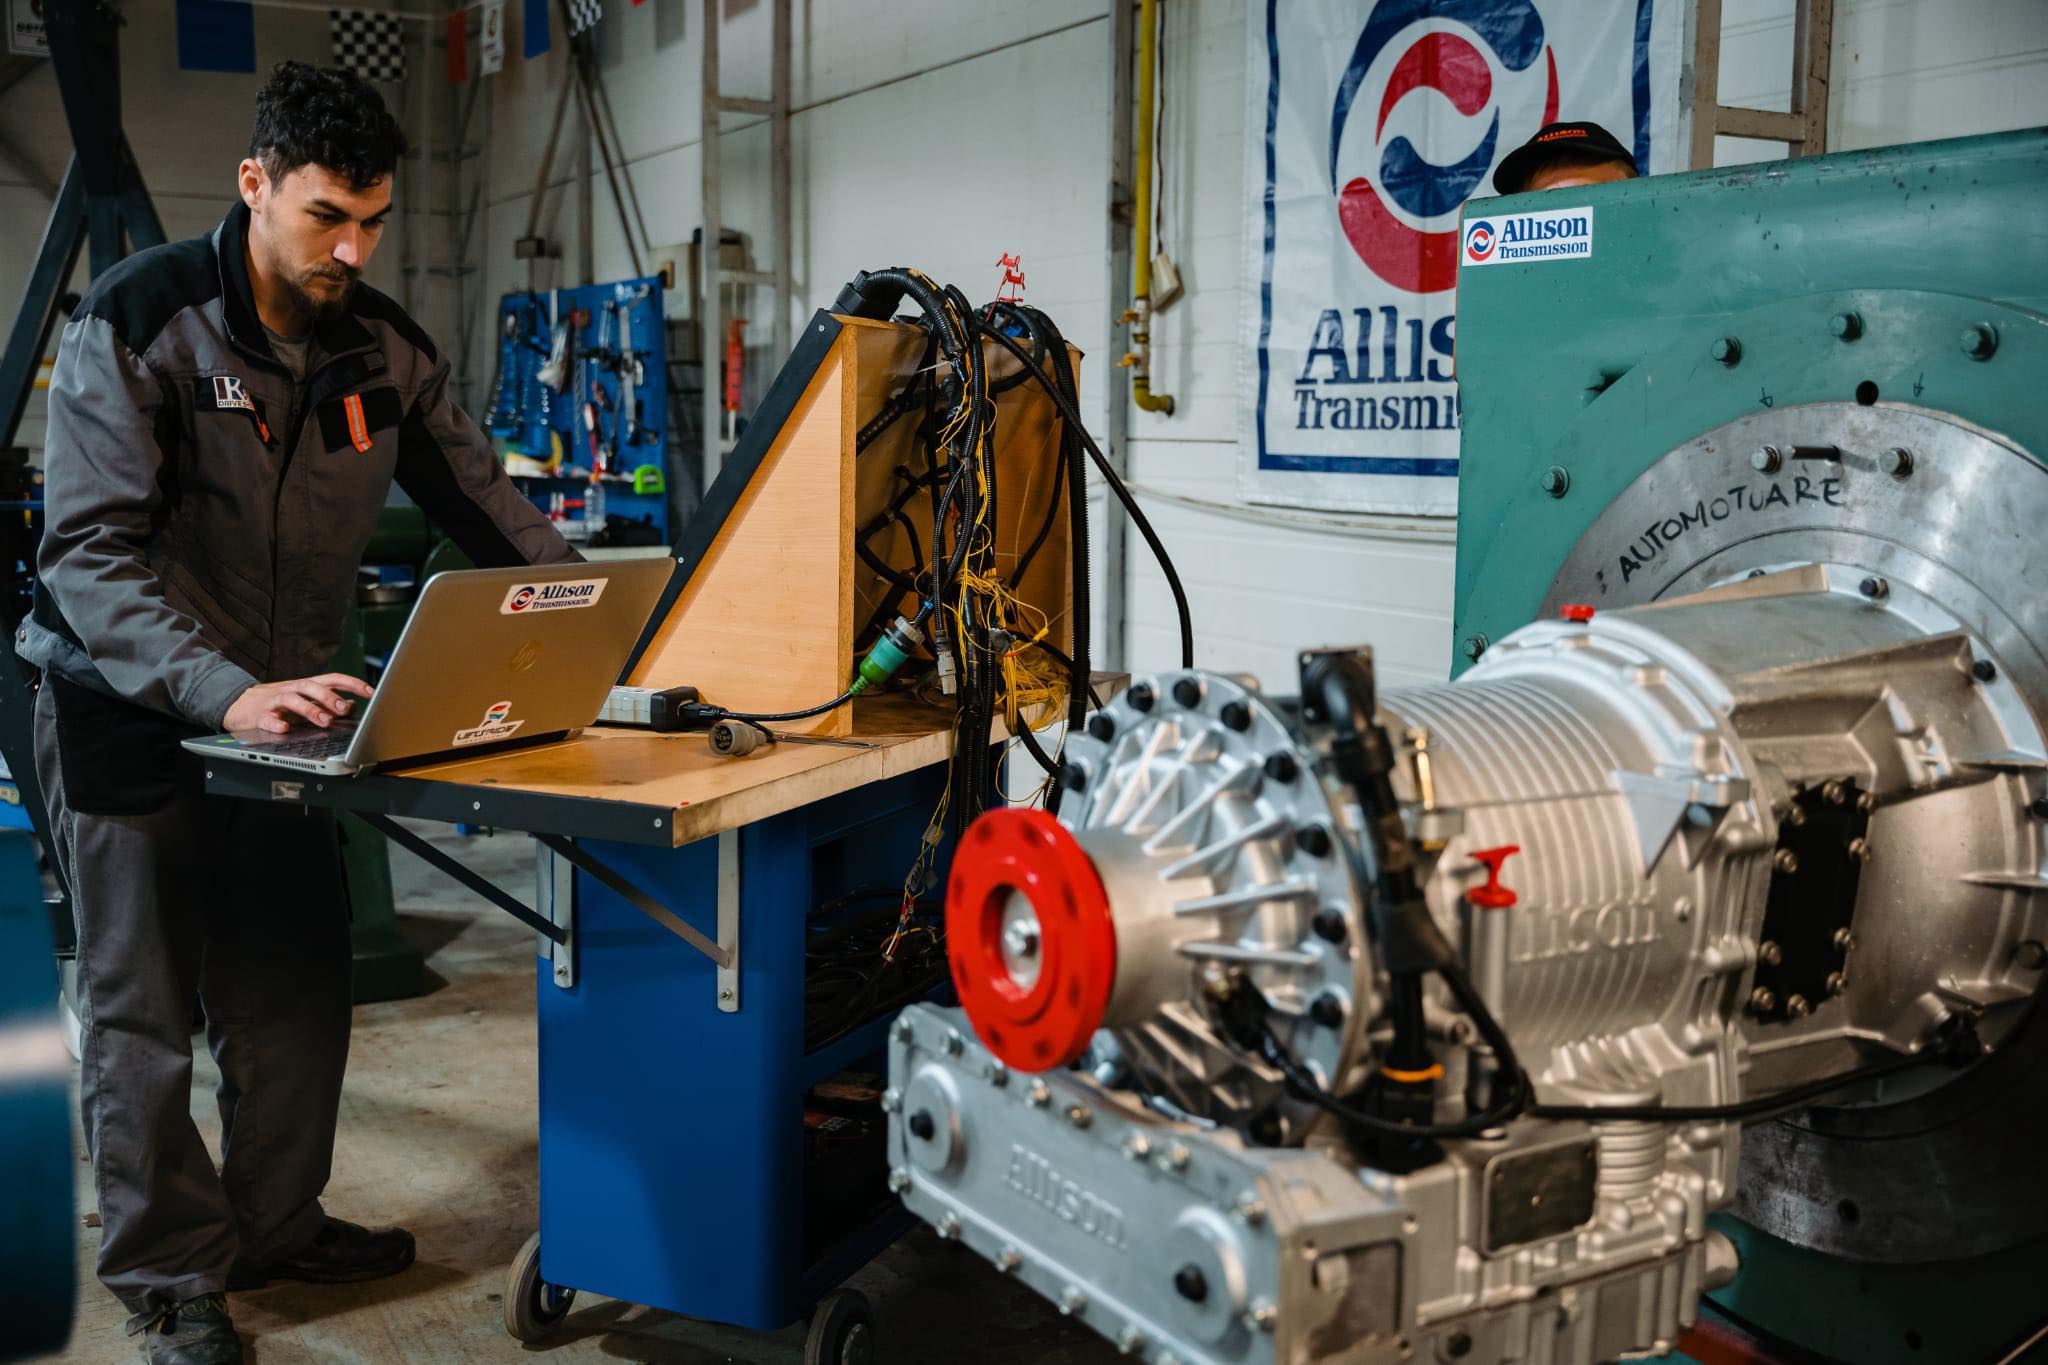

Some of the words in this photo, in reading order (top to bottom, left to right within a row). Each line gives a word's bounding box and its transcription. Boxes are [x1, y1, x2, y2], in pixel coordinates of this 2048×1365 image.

[1499, 217, 1588, 243] Allison
[1499, 241, 1588, 259] Transmission
[1295, 305, 1455, 385] Allis
[1295, 389, 1456, 430] Transmi
[535, 585, 595, 600] Allison
